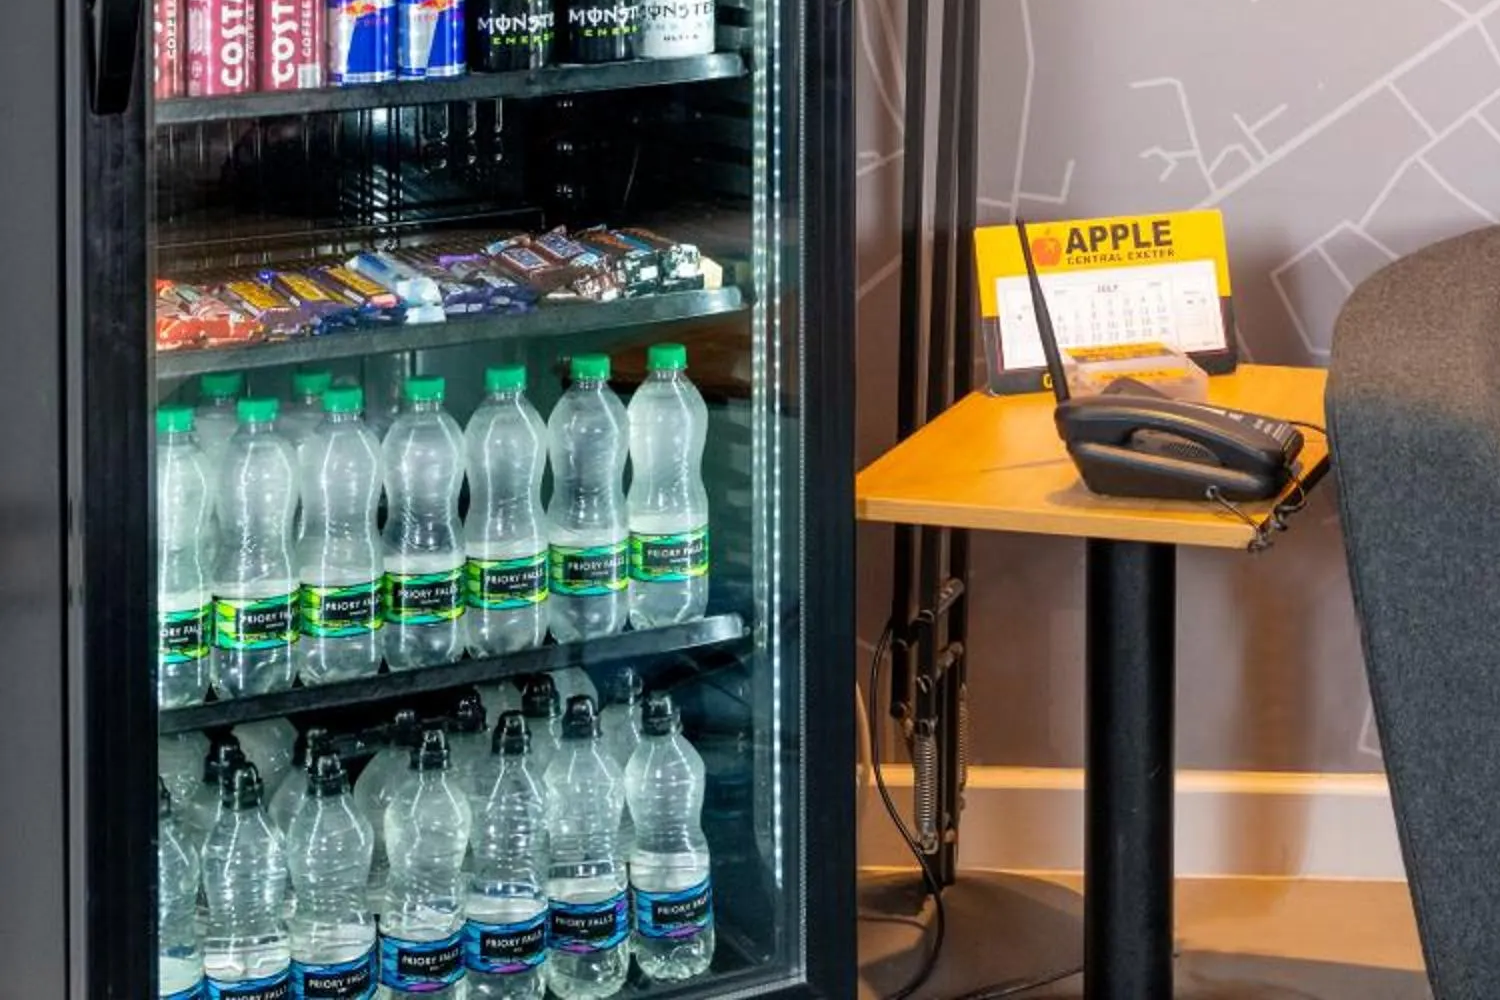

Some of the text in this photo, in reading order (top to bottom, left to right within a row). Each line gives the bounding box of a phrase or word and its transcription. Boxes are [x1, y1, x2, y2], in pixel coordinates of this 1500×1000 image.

[568, 3, 638, 28] MONST
[301, 0, 312, 57] COFFEE
[1065, 220, 1173, 254] APPLE
[1066, 248, 1176, 266] CENTRAL EXETER
[647, 547, 682, 559] PRIORY
[567, 559, 602, 572] PRIORY
[484, 574, 521, 585] PRIORY
[397, 588, 434, 600] PRIORY
[325, 600, 361, 612] PRIORY
[240, 613, 278, 625] PRIORY
[160, 626, 182, 638] ORY
[657, 902, 692, 916] PRIORY
[555, 913, 614, 929] PRIORY FALLS
[485, 934, 521, 949] PRIORY
[401, 954, 438, 967] PRIORY
[308, 977, 345, 990] PRIORY
